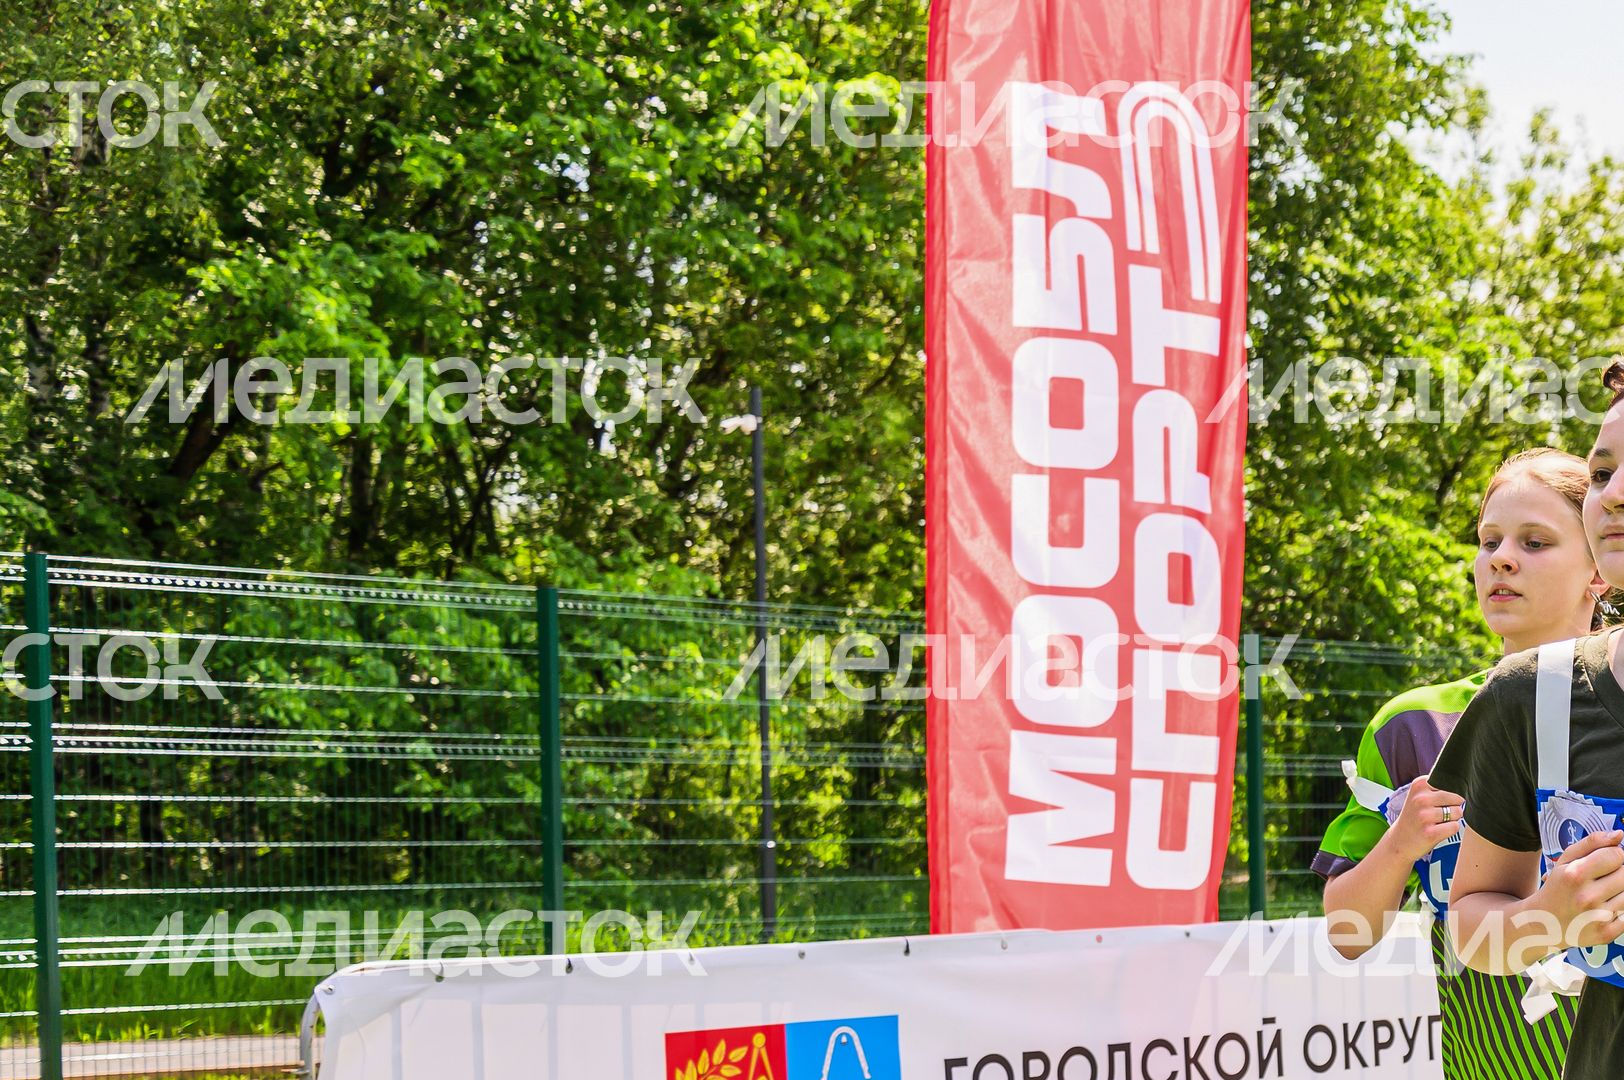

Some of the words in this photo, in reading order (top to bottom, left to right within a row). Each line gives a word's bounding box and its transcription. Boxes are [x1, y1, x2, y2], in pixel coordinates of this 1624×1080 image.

[1004, 82, 1120, 888] МОСОБЛ
[1125, 262, 1222, 891] СПОРТ
[1302, 1013, 1442, 1074] ОКРУГ
